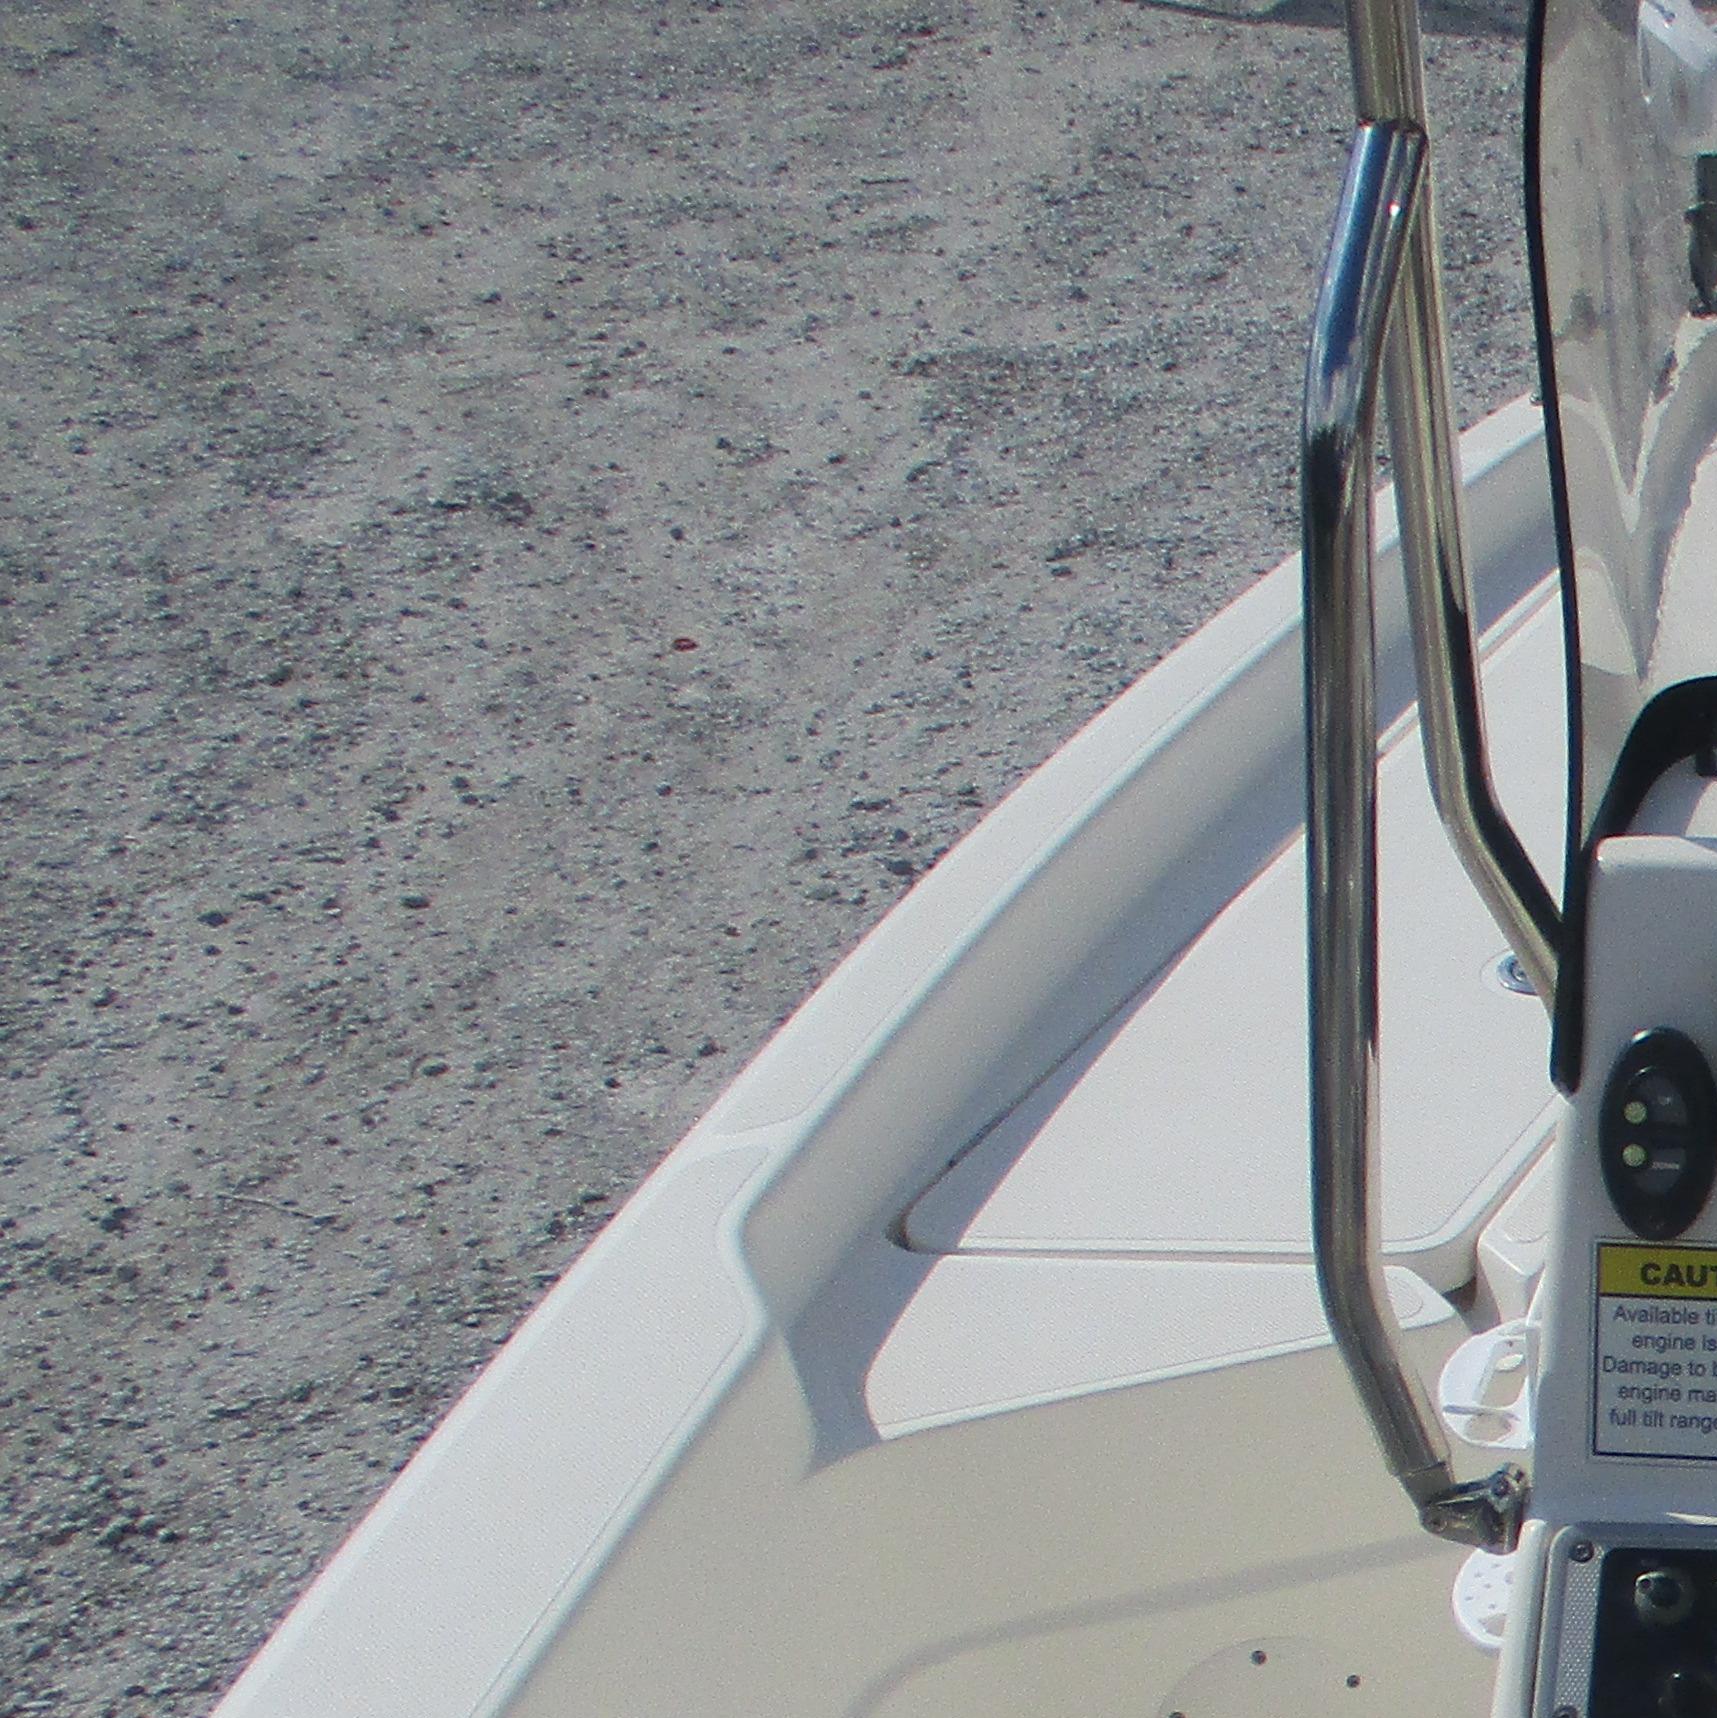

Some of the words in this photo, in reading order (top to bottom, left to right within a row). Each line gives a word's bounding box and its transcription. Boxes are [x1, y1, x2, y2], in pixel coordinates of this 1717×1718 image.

[1613, 1305, 1700, 1326] Available
[1632, 1335, 1696, 1354] engine
[1702, 1335, 1717, 1352] is
[1602, 1356, 1683, 1378] Damage
[1687, 1360, 1707, 1377] to
[1618, 1384, 1682, 1403] engine
[1609, 1408, 1637, 1427] full
[1642, 1410, 1664, 1428] tilt
